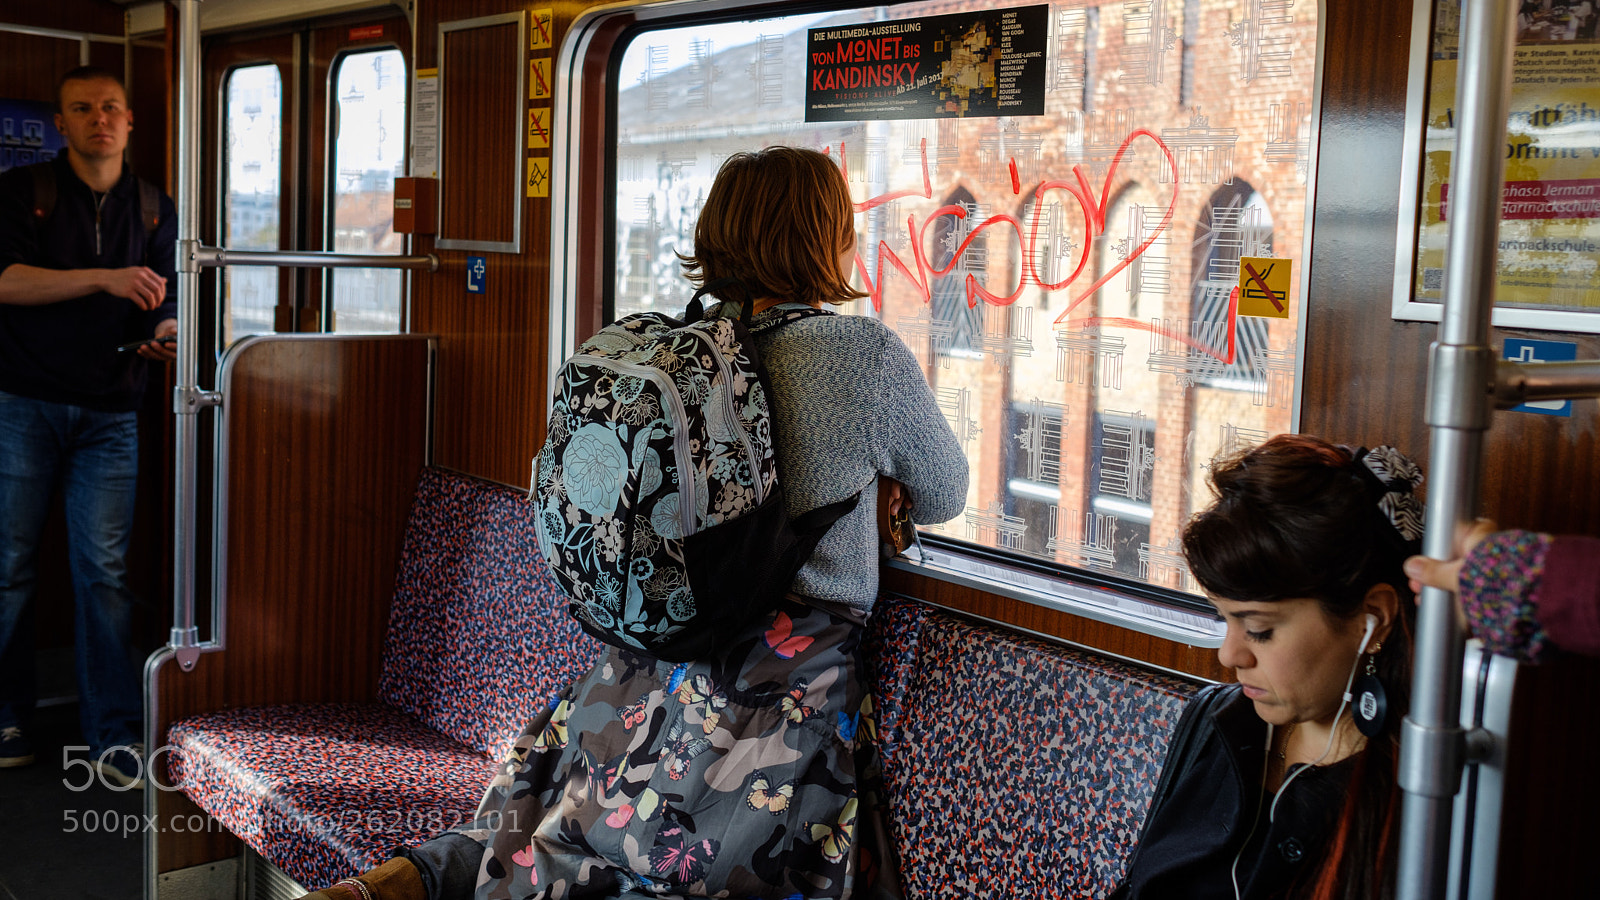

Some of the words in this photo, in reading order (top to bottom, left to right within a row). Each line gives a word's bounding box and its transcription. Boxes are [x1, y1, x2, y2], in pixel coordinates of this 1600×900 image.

[814, 32, 825, 41] DIE
[827, 23, 921, 40] MULTIMEDIA-AUSSTELLUNG
[812, 51, 834, 66] VON
[837, 37, 902, 64] MONET
[903, 44, 920, 58] BIS
[812, 62, 920, 91] KANDINSKY
[1512, 68, 1598, 76] ntegrationsunterricht,
[896, 85, 905, 95] Ab
[906, 83, 916, 92] 21.
[917, 75, 928, 89] Juli
[928, 72, 944, 83] 2017
[874, 90, 896, 98] ALIVE
[1508, 103, 1600, 125] mitfäh
[1542, 184, 1594, 198] Jerman
[1499, 237, 1600, 252] artnackschule-
